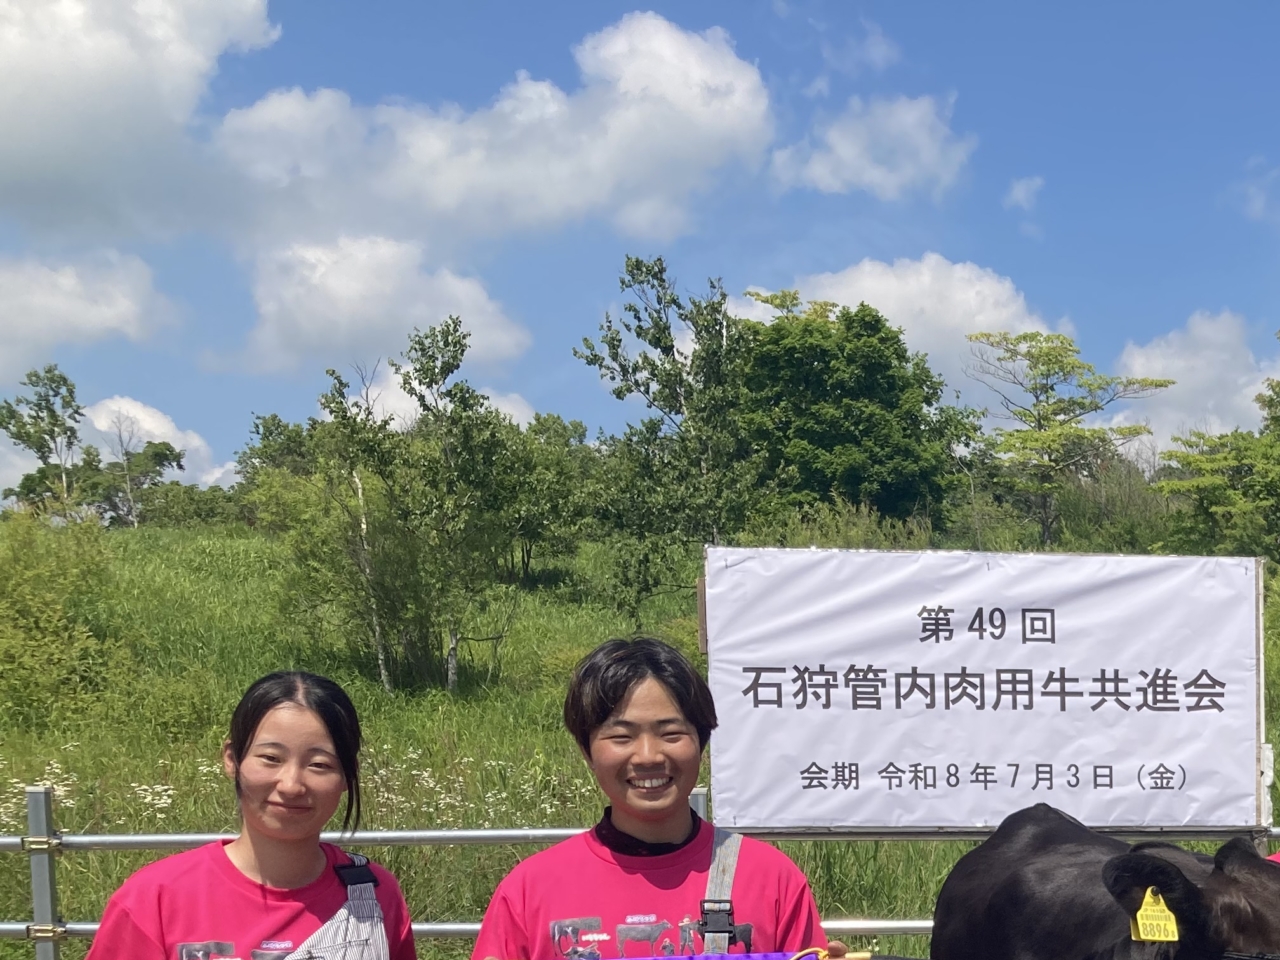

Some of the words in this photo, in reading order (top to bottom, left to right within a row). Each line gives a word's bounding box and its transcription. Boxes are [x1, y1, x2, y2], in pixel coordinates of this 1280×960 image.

[741, 663, 1227, 713] 石狩管内肉用牛共進会
[800, 761, 860, 790] 会期
